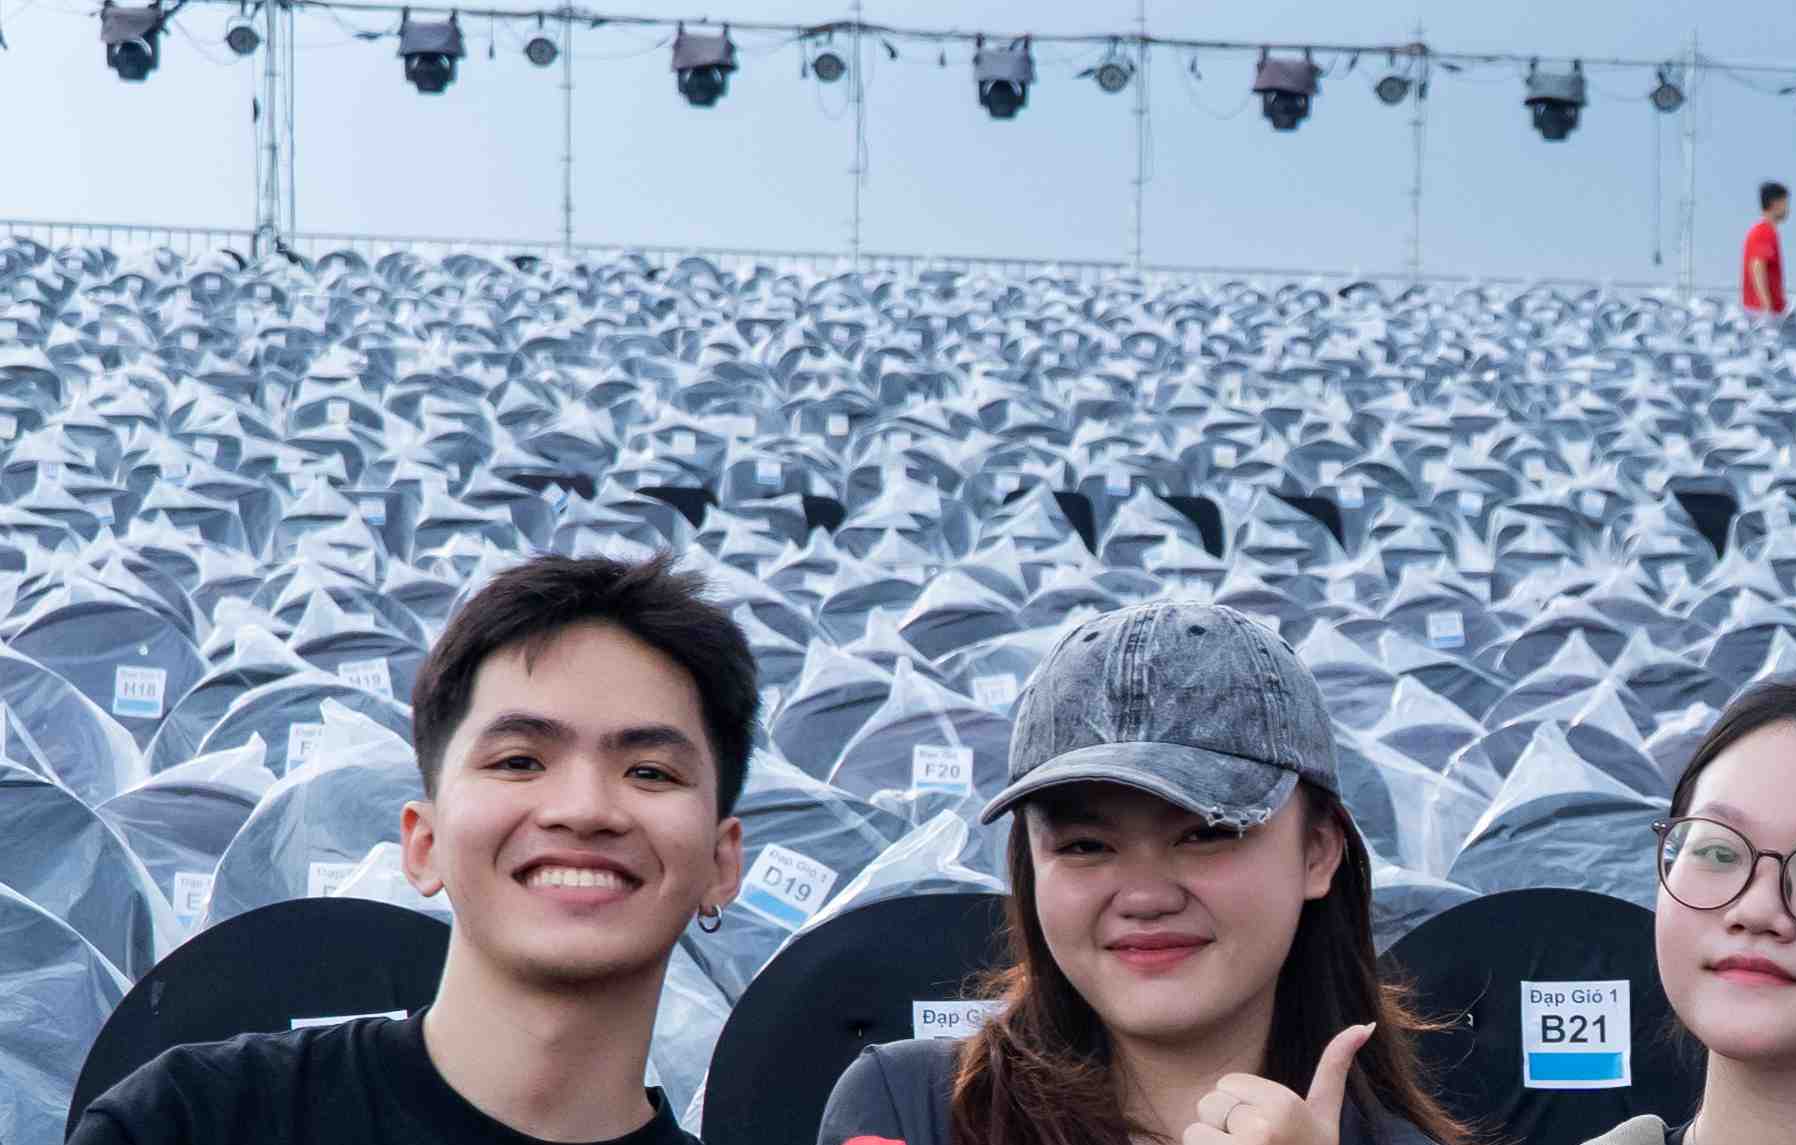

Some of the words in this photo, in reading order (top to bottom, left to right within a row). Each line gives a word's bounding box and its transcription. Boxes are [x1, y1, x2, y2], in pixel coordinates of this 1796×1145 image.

[925, 763, 962, 779] F20
[762, 865, 812, 903] D19
[1530, 989, 1566, 1007] Đạp
[1609, 988, 1617, 1003] 1
[922, 1008, 960, 1028] Đạp
[1541, 1014, 1606, 1043] B21
